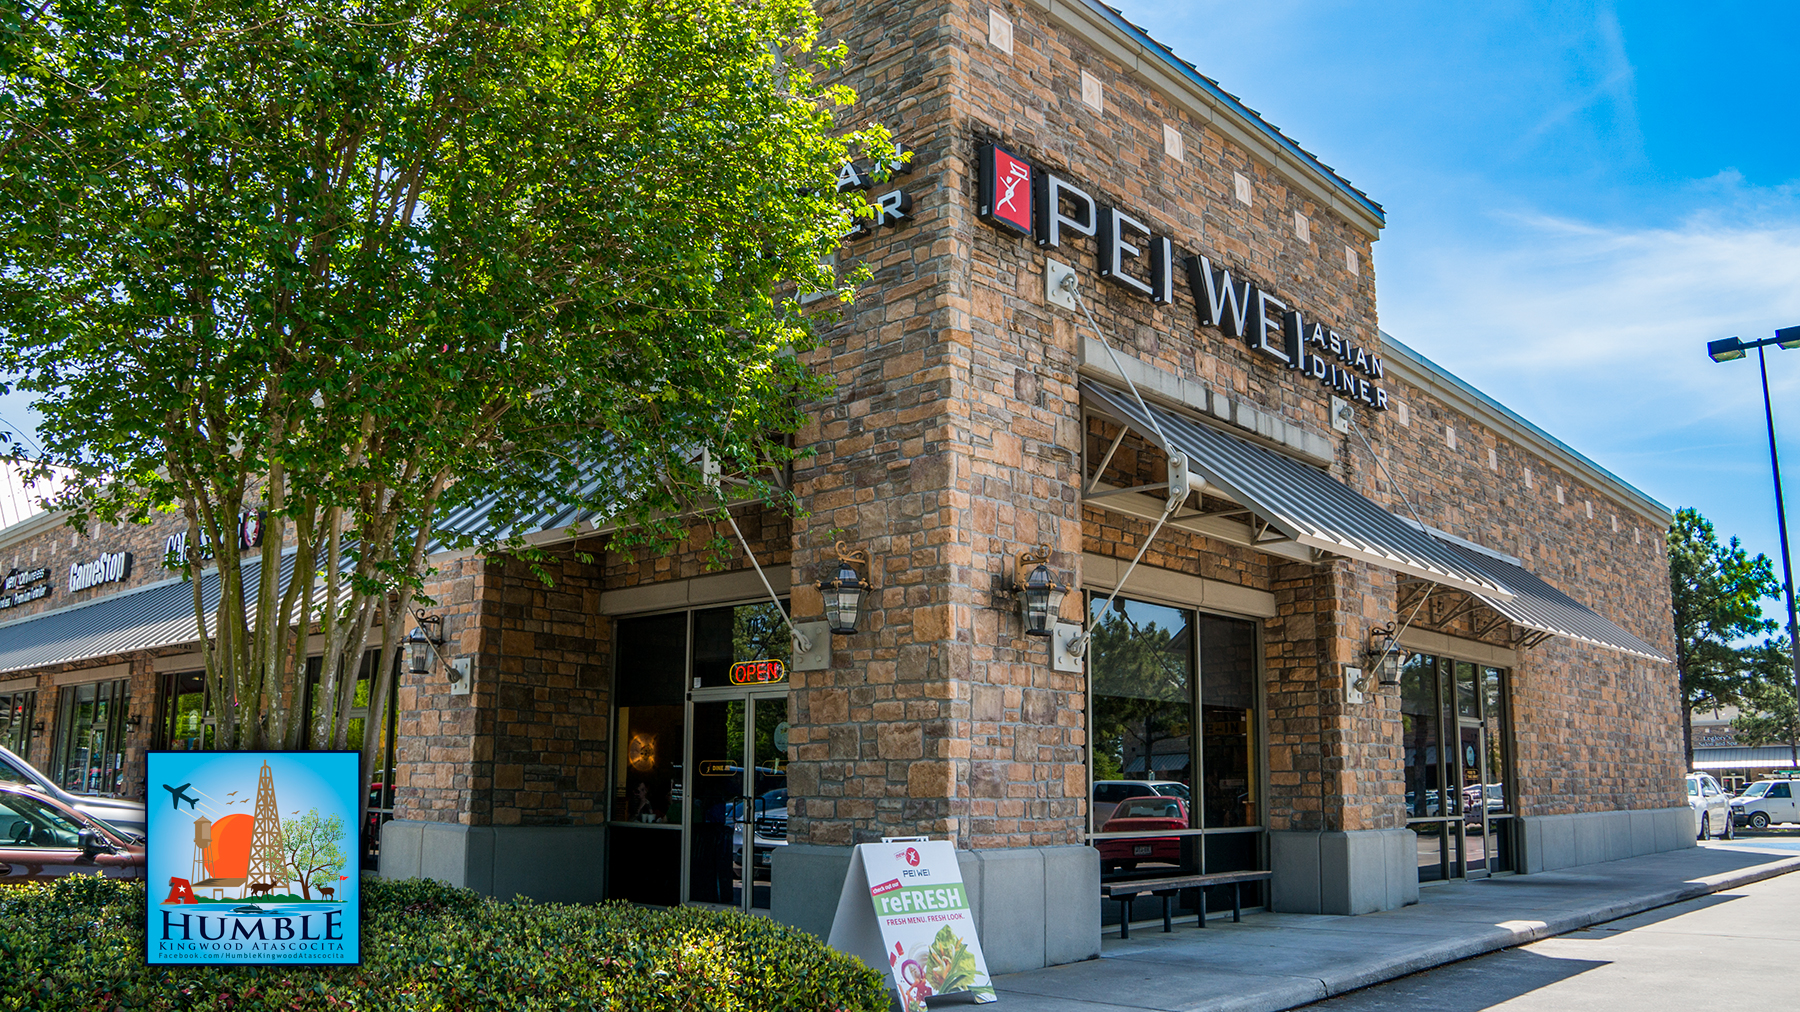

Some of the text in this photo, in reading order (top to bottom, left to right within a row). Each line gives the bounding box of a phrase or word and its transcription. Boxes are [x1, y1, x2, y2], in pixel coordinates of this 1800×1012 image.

[1047, 173, 1304, 370] PEI WEI
[1311, 322, 1383, 378] ASIAN
[1312, 354, 1389, 411] DINER
[69, 551, 126, 592] GameStop
[735, 661, 779, 683] OPEN
[880, 888, 962, 914] reFRESH
[886, 913, 966, 926] FRESH MENU. FRESH LOOK.
